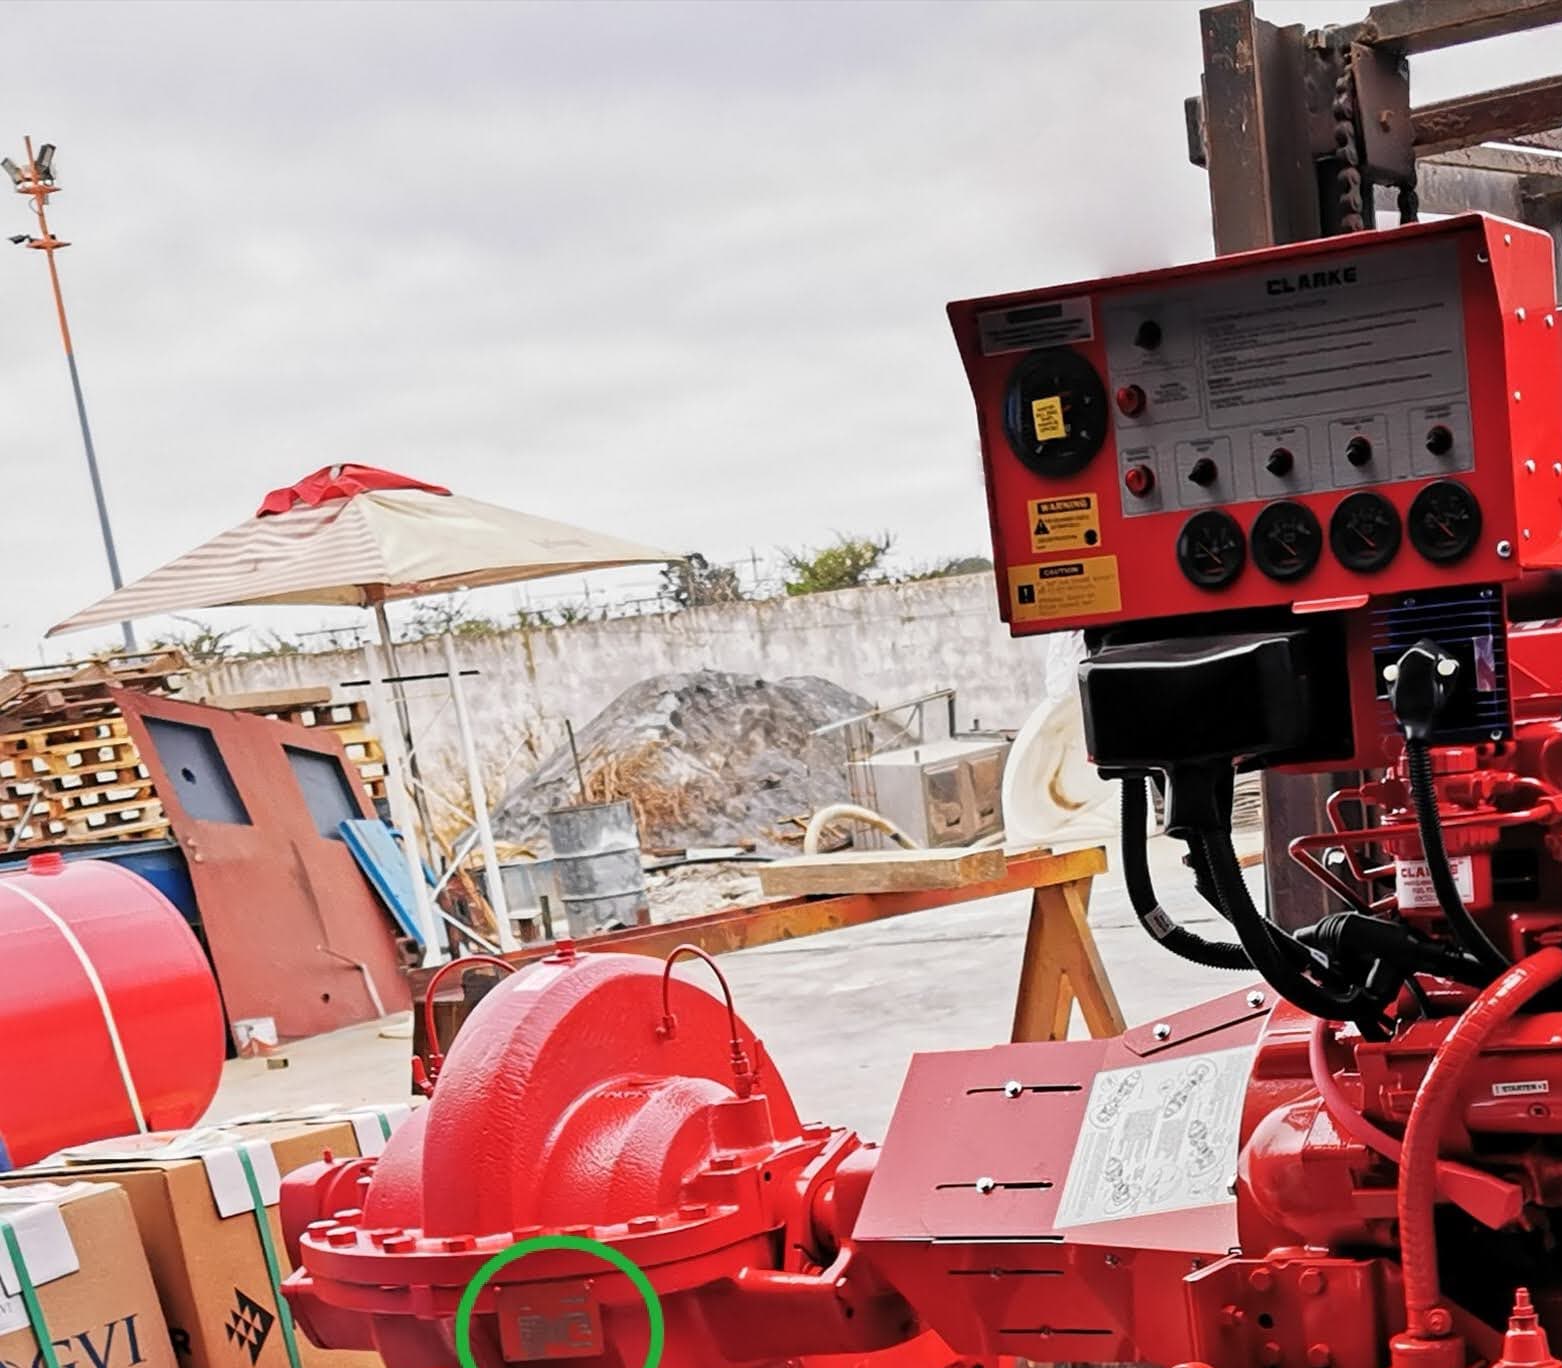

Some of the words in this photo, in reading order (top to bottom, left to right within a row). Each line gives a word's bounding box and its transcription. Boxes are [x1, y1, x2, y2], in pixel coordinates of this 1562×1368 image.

[1266, 267, 1358, 295] CLARKE
[1039, 498, 1089, 513] WARNING
[1042, 567, 1080, 577] CAUTION
